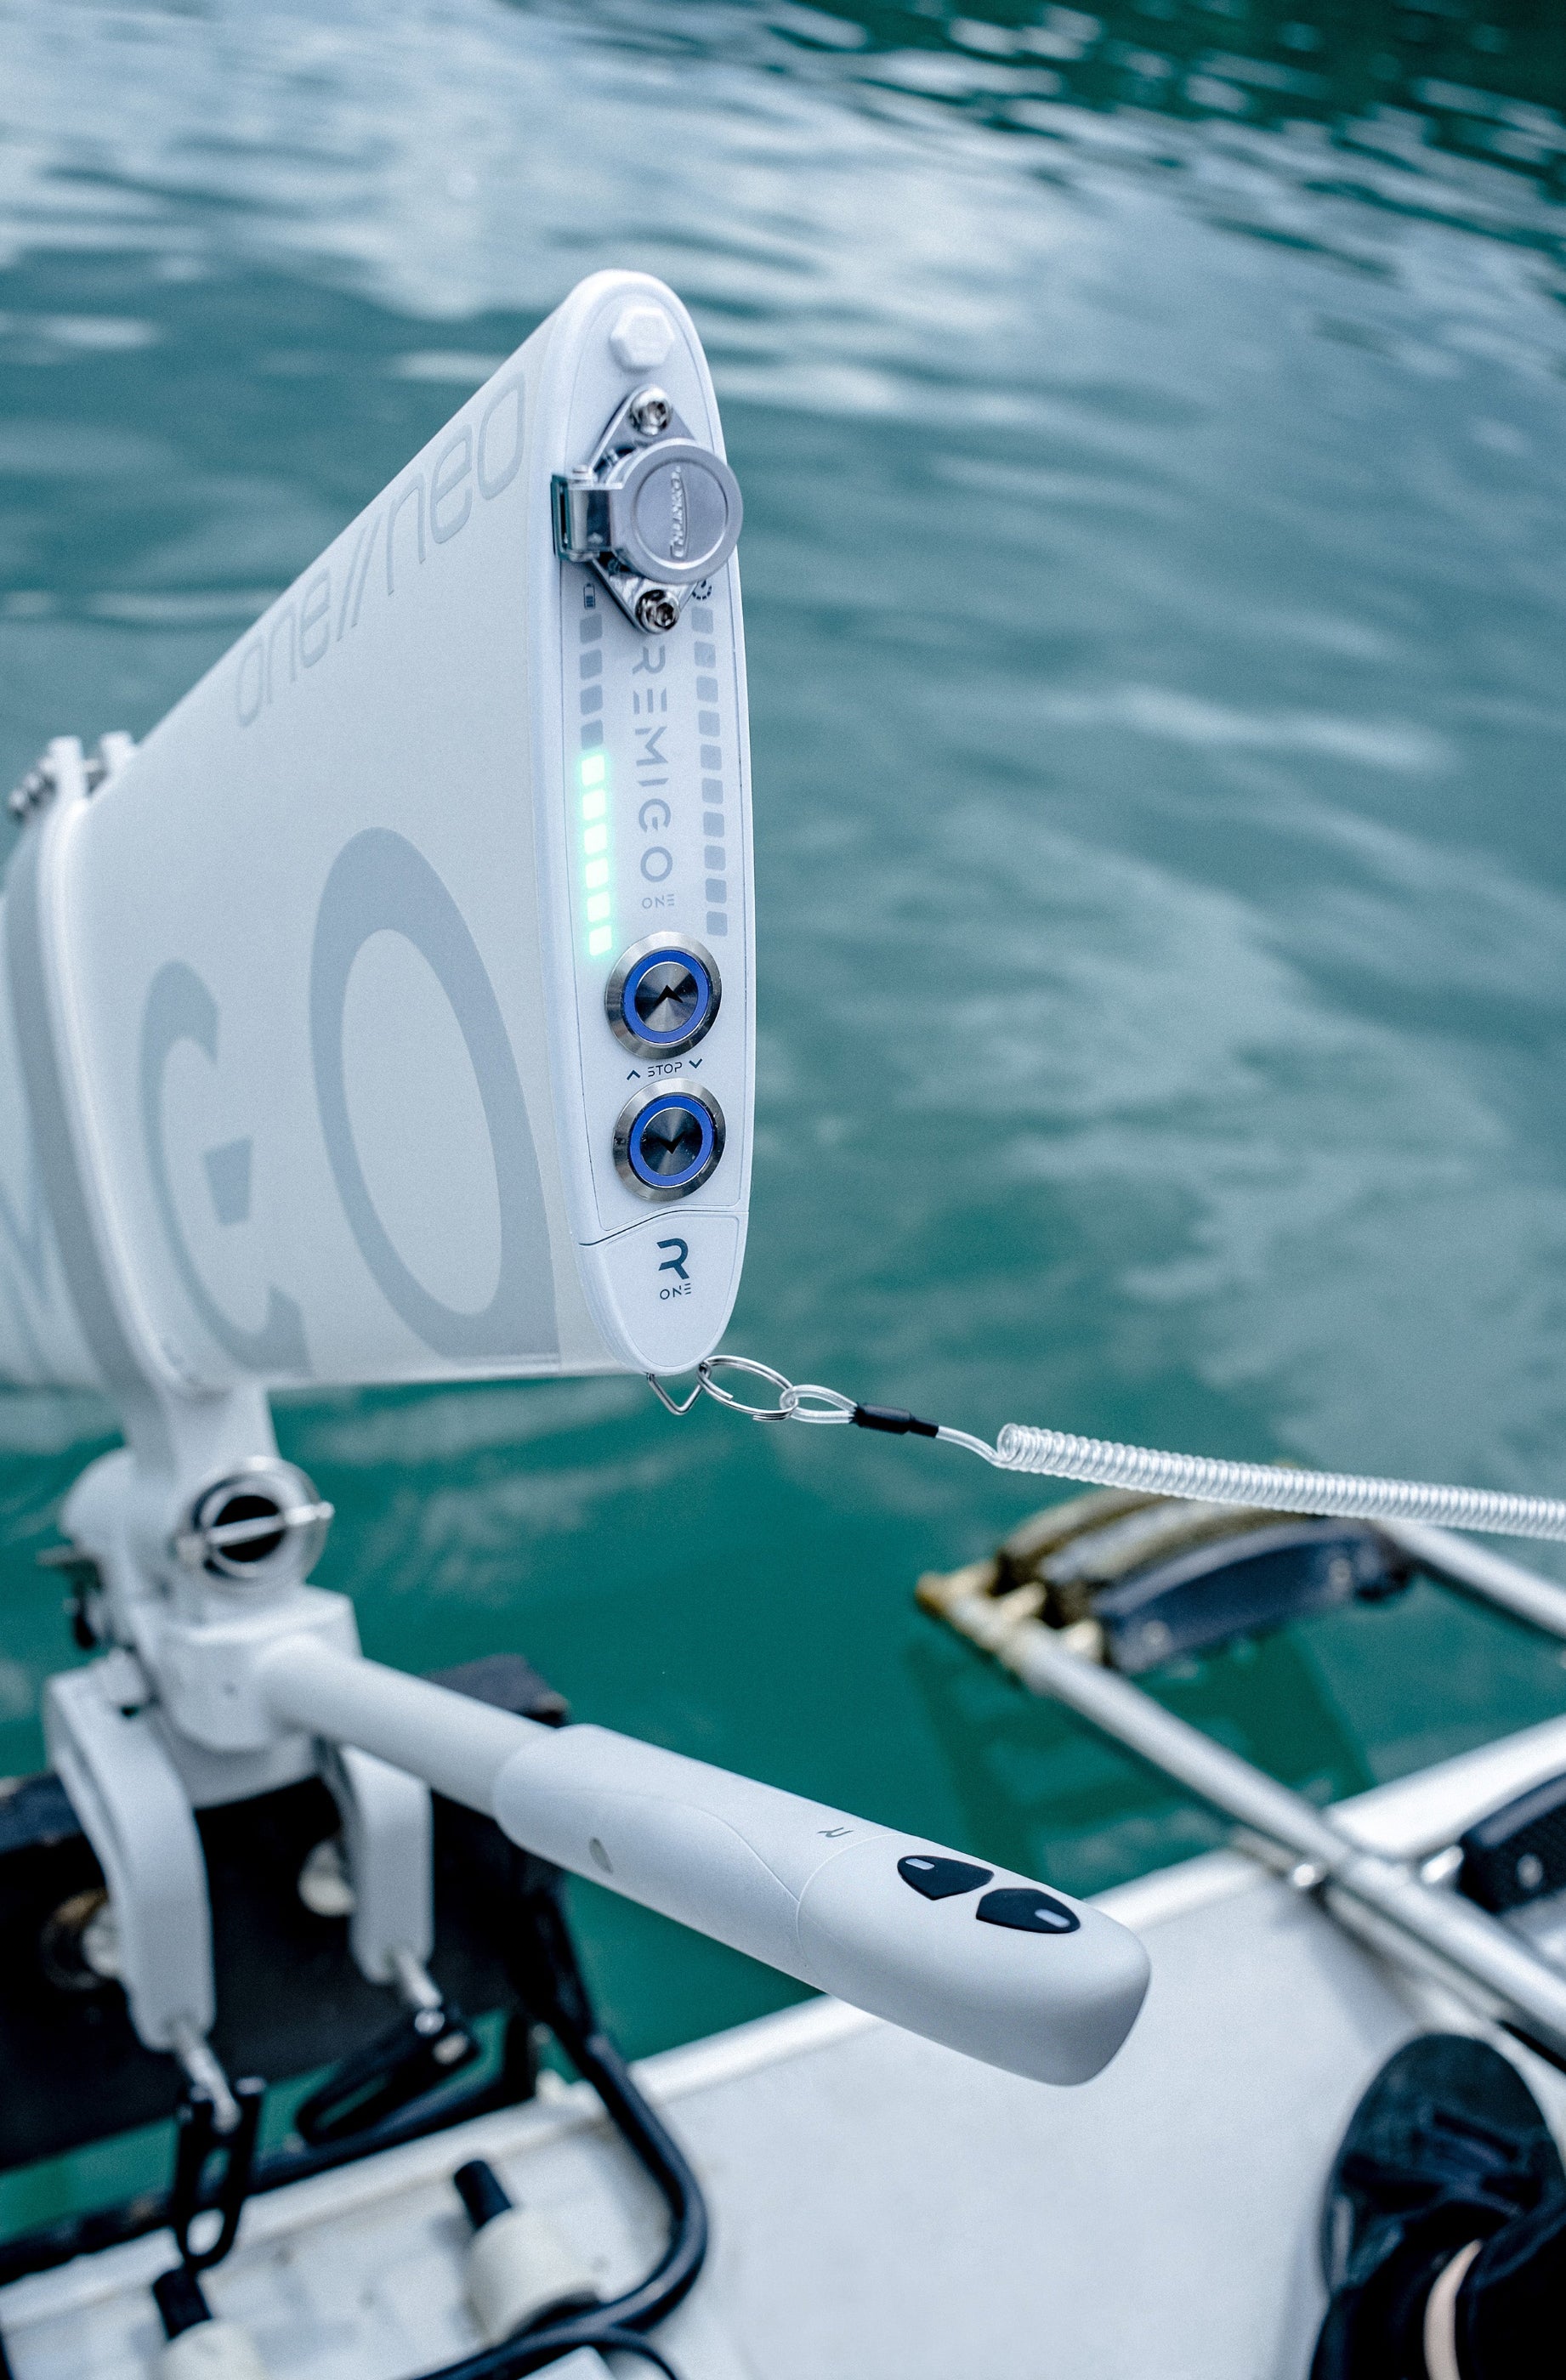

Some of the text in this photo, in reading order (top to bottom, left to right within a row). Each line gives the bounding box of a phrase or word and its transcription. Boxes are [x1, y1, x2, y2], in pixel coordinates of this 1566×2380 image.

[632, 643, 673, 883] REMIGO
[642, 893, 675, 910] ONE
[647, 1062, 683, 1078] STOP
[656, 1238, 689, 1280] R
[659, 1283, 692, 1300] ONE
